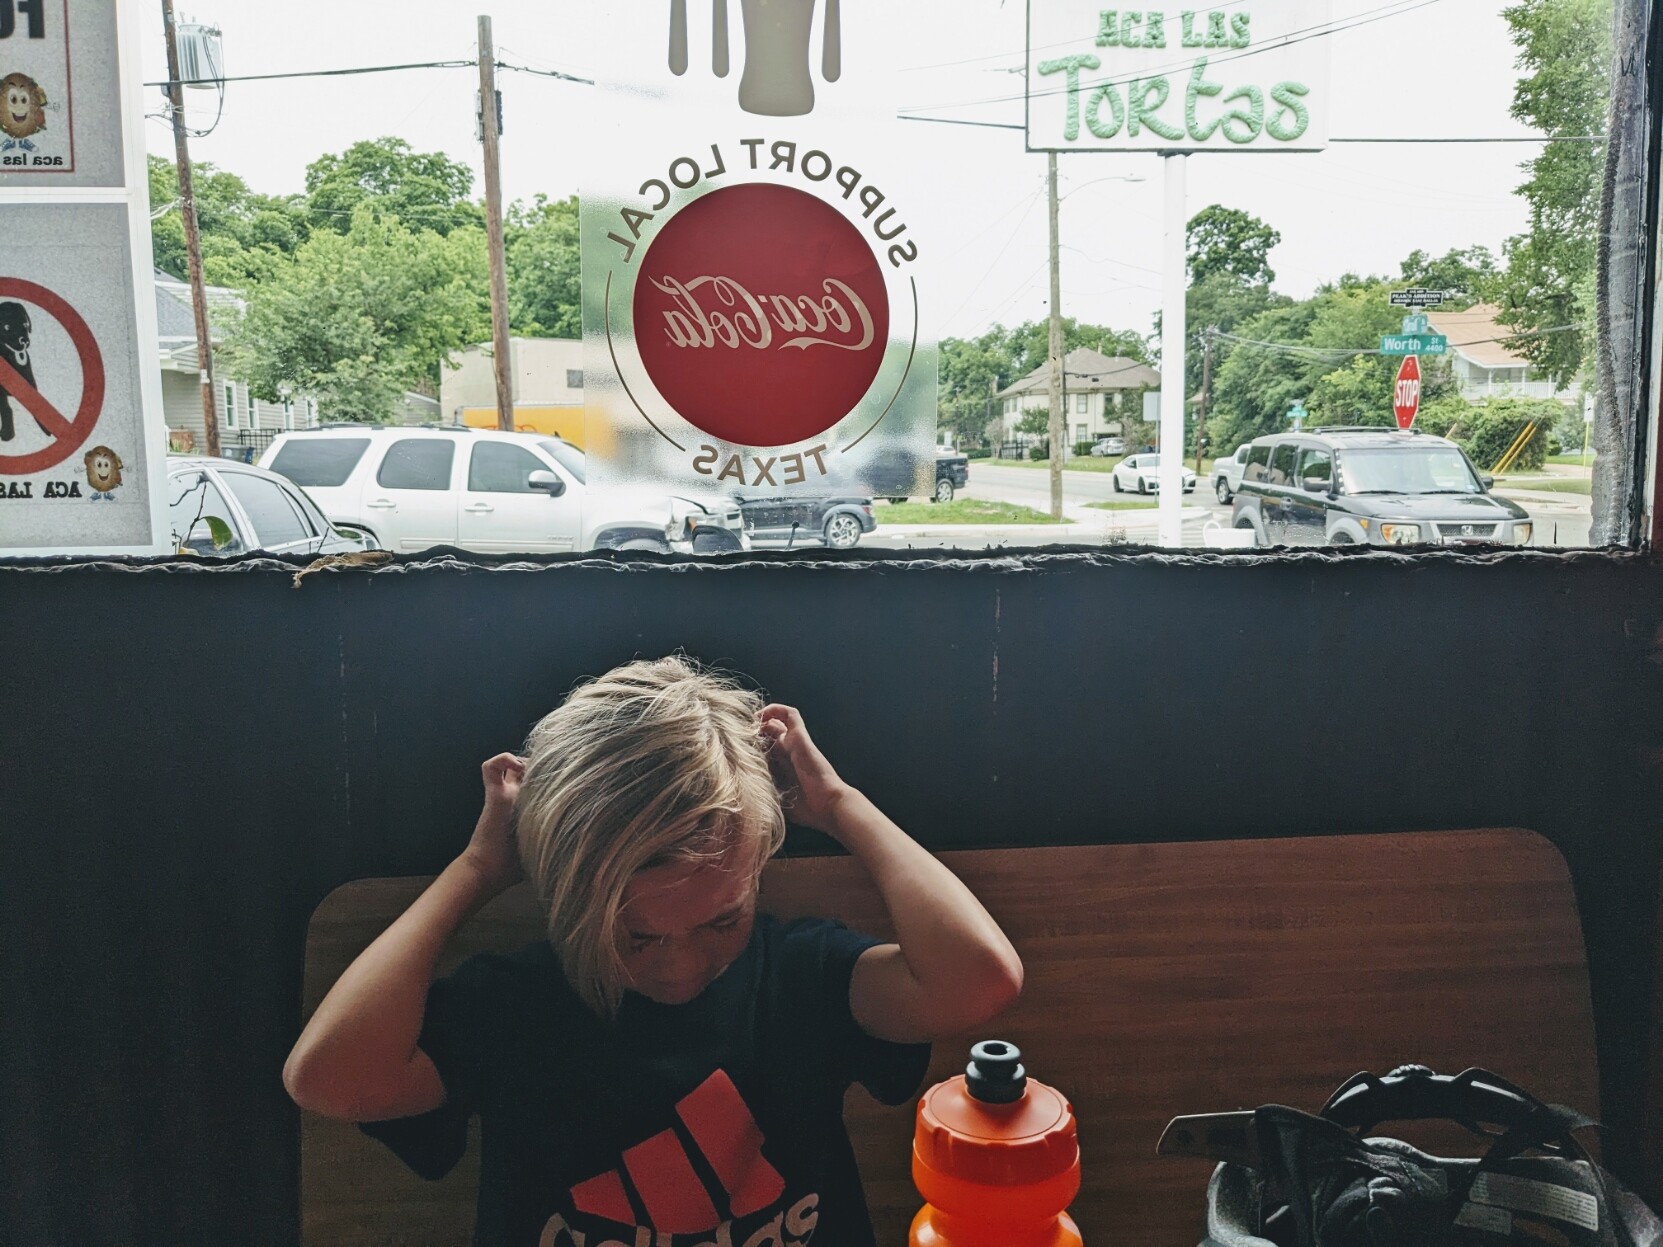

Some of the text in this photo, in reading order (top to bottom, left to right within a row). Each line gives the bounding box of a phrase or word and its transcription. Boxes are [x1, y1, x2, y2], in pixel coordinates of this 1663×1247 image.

[1095, 10, 1250, 48] ACA LAS
[1384, 338, 1421, 350] Worth
[1396, 379, 1419, 408] STOP
